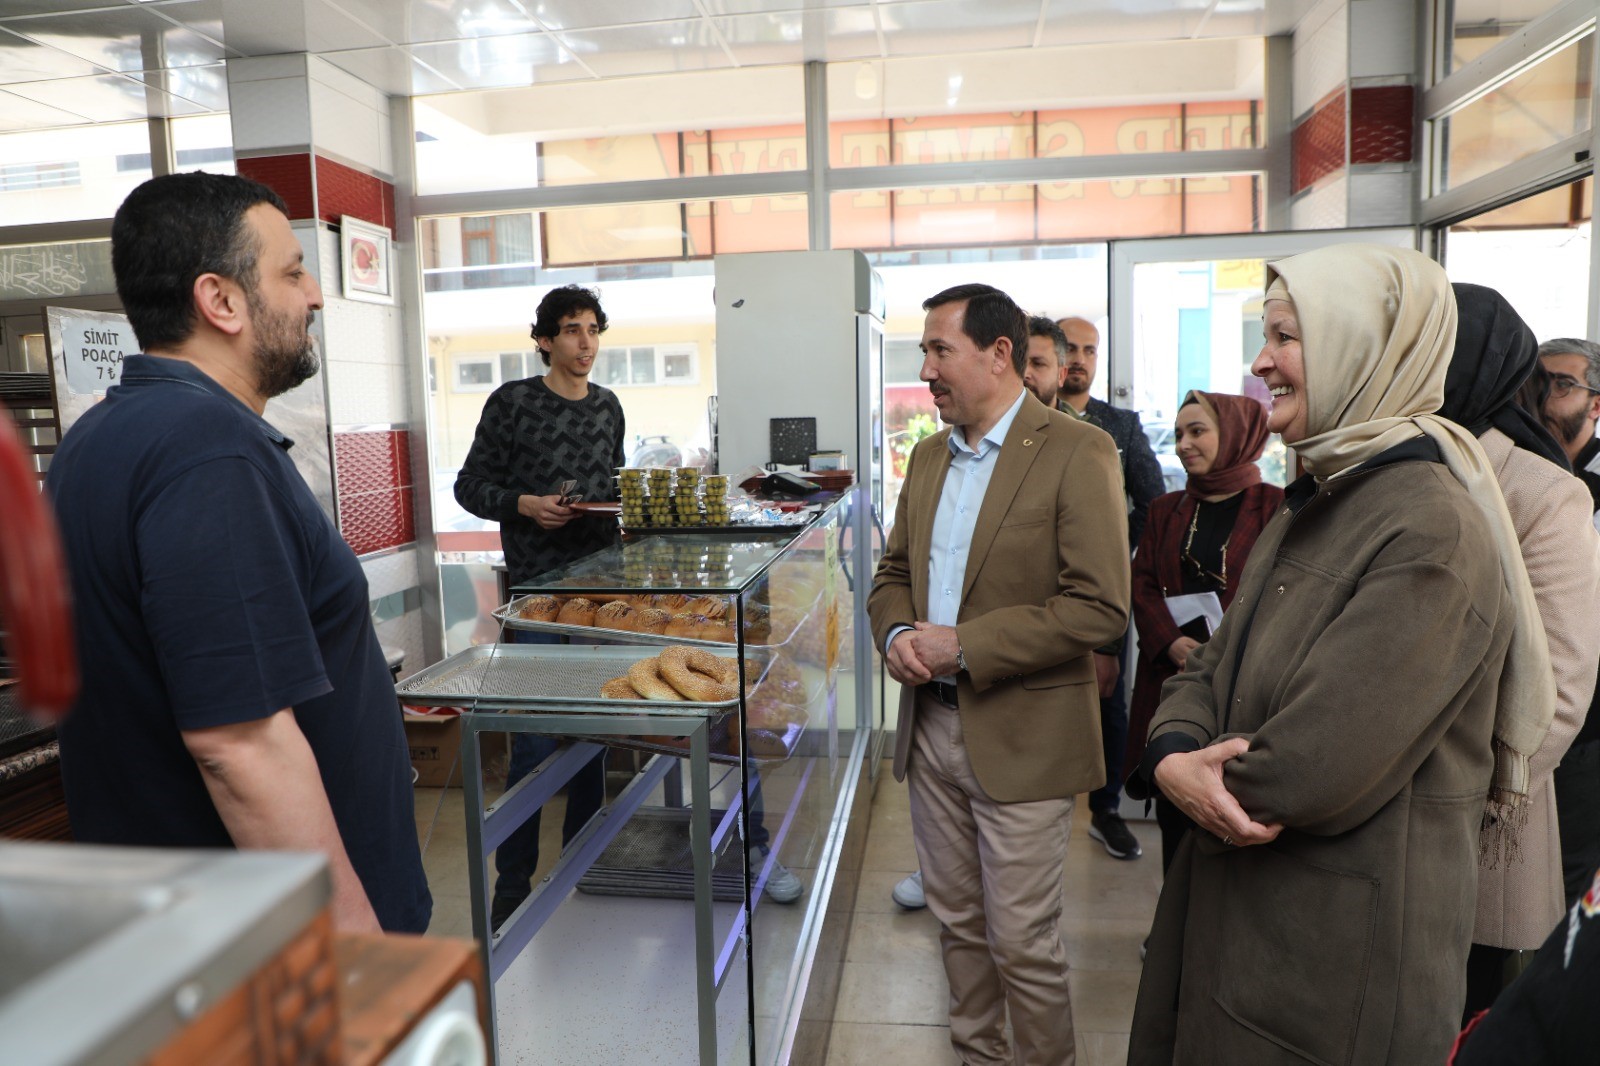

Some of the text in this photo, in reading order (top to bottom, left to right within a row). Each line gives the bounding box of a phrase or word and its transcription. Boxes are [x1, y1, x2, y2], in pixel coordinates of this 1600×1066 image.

[84, 328, 119, 346] SİMİT
[82, 348, 124, 366] POAÇA
[97, 367, 103, 379] 7
